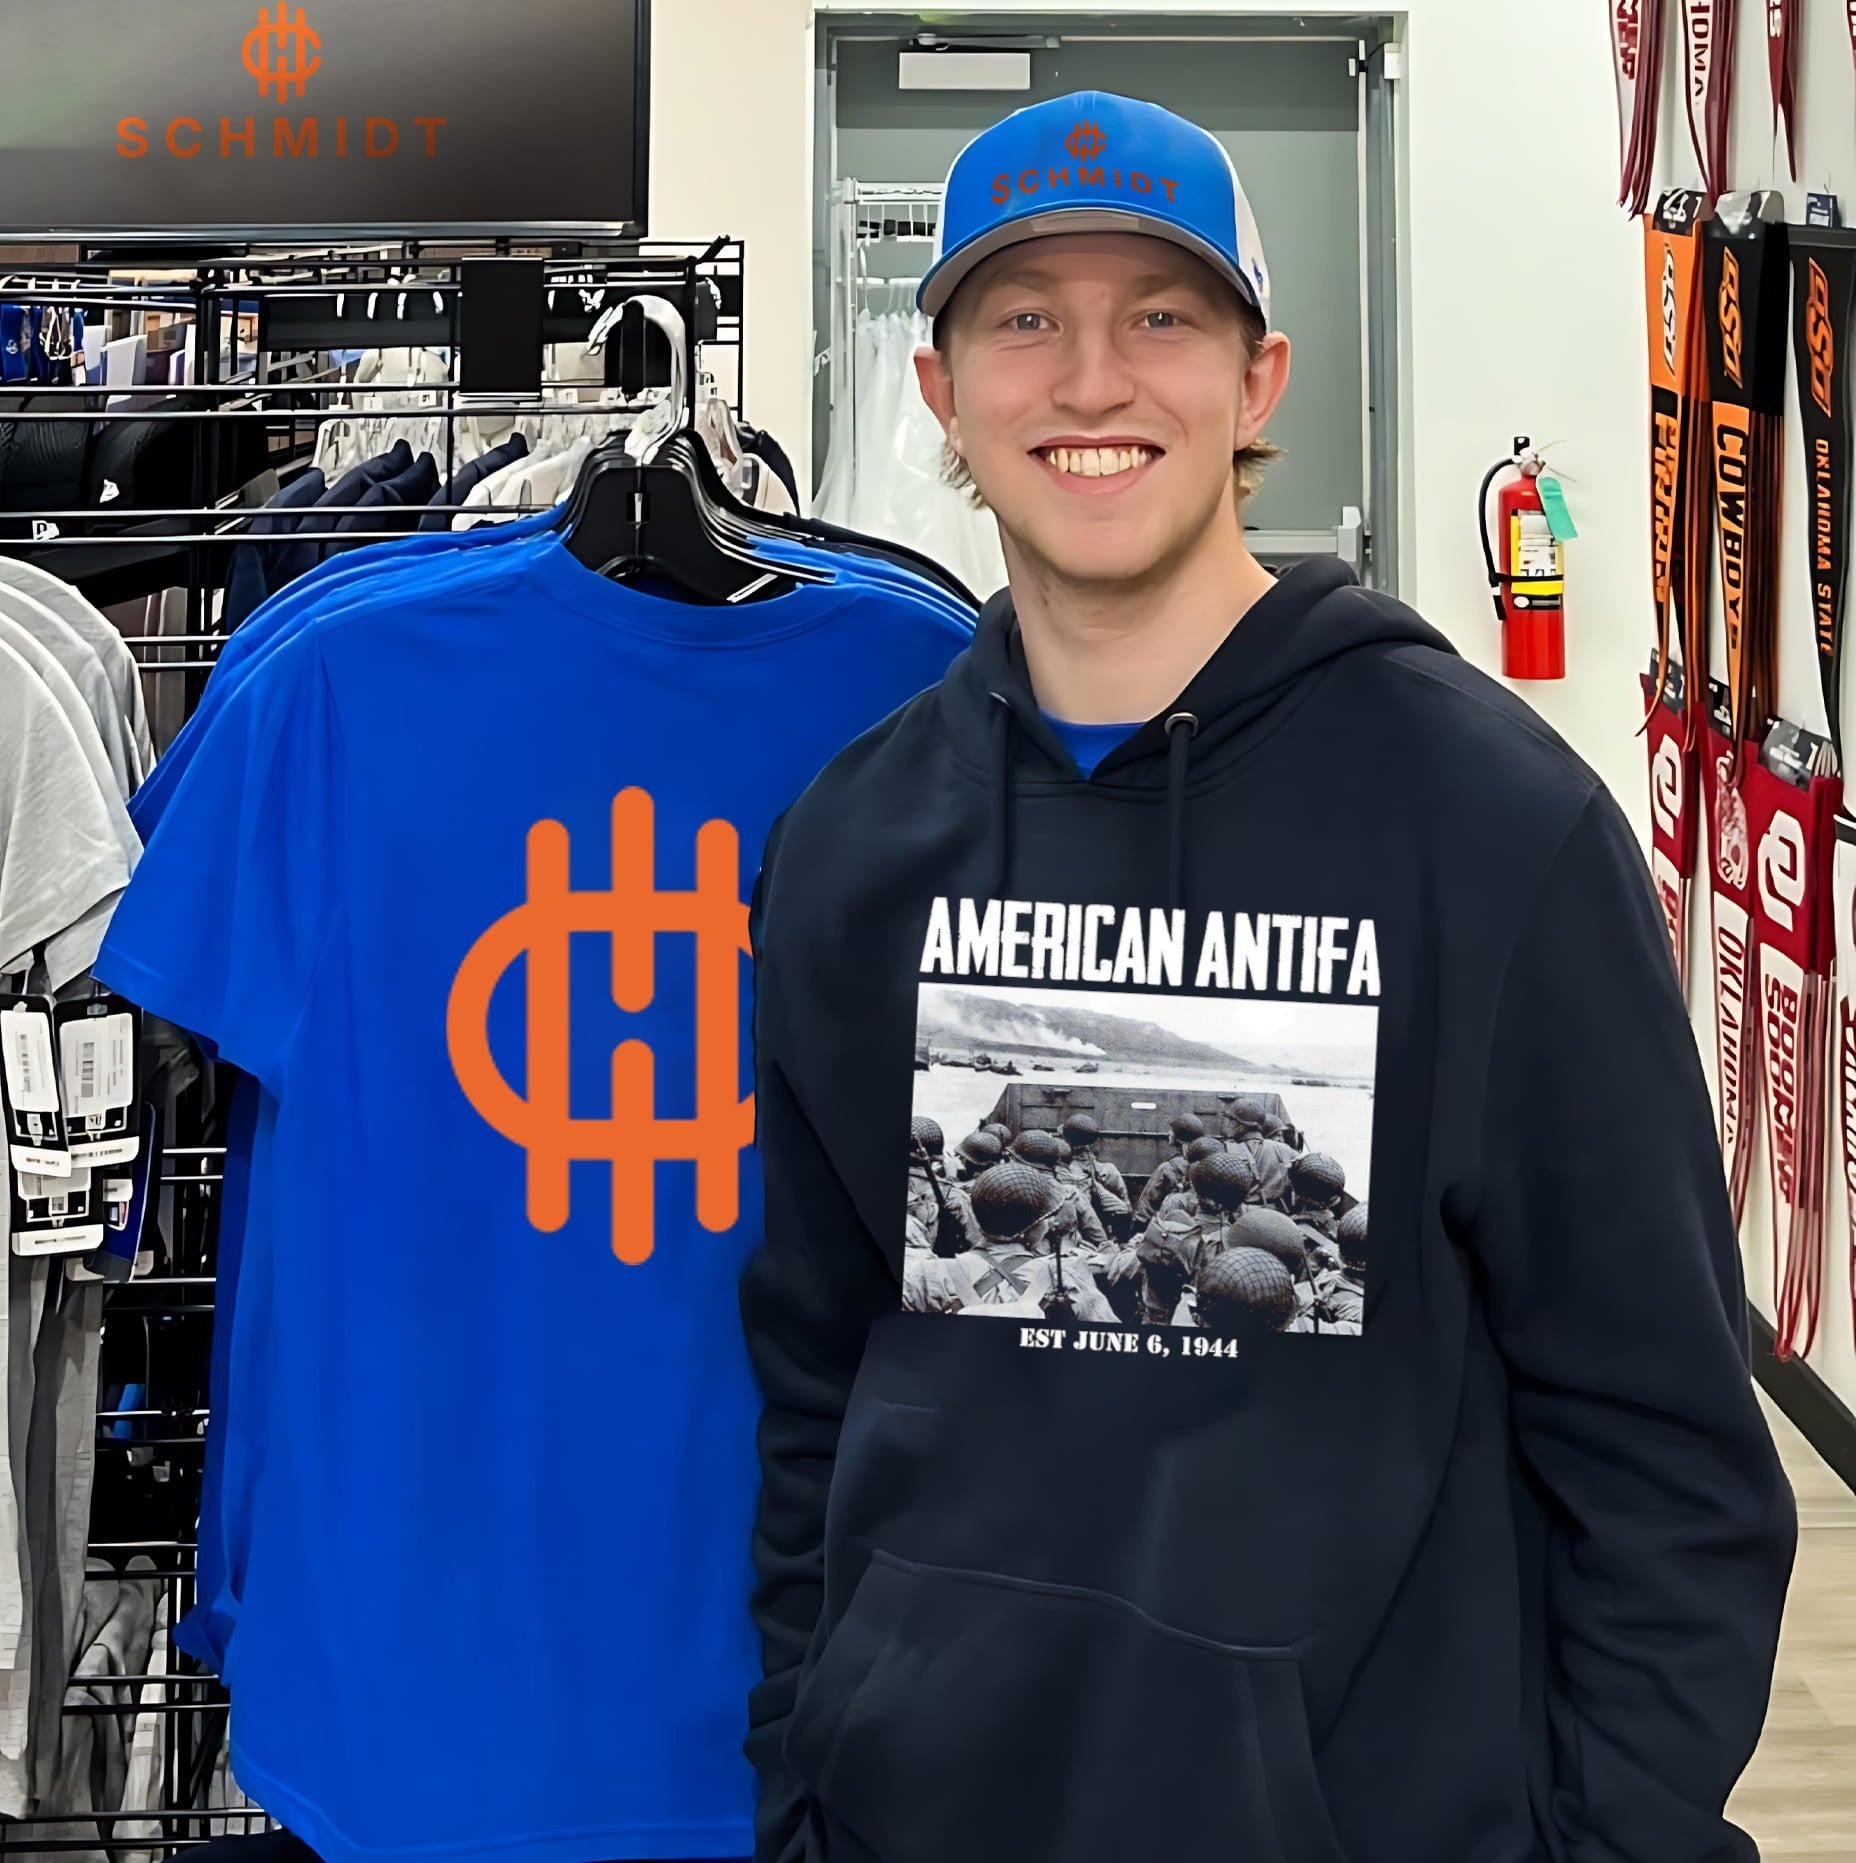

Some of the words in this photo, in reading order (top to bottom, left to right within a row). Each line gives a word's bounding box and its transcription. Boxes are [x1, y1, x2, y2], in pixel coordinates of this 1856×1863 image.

[115, 115, 447, 159] SCHMIDT
[991, 167, 1178, 204] SCHMIDT
[919, 896, 1186, 987] AMERICAN
[1194, 910, 1381, 997] ANTIFA
[1019, 1327, 1067, 1349] EST
[1072, 1330, 1139, 1353] JUNE
[1146, 1334, 1170, 1358] 6,
[1181, 1335, 1239, 1358] 1944
